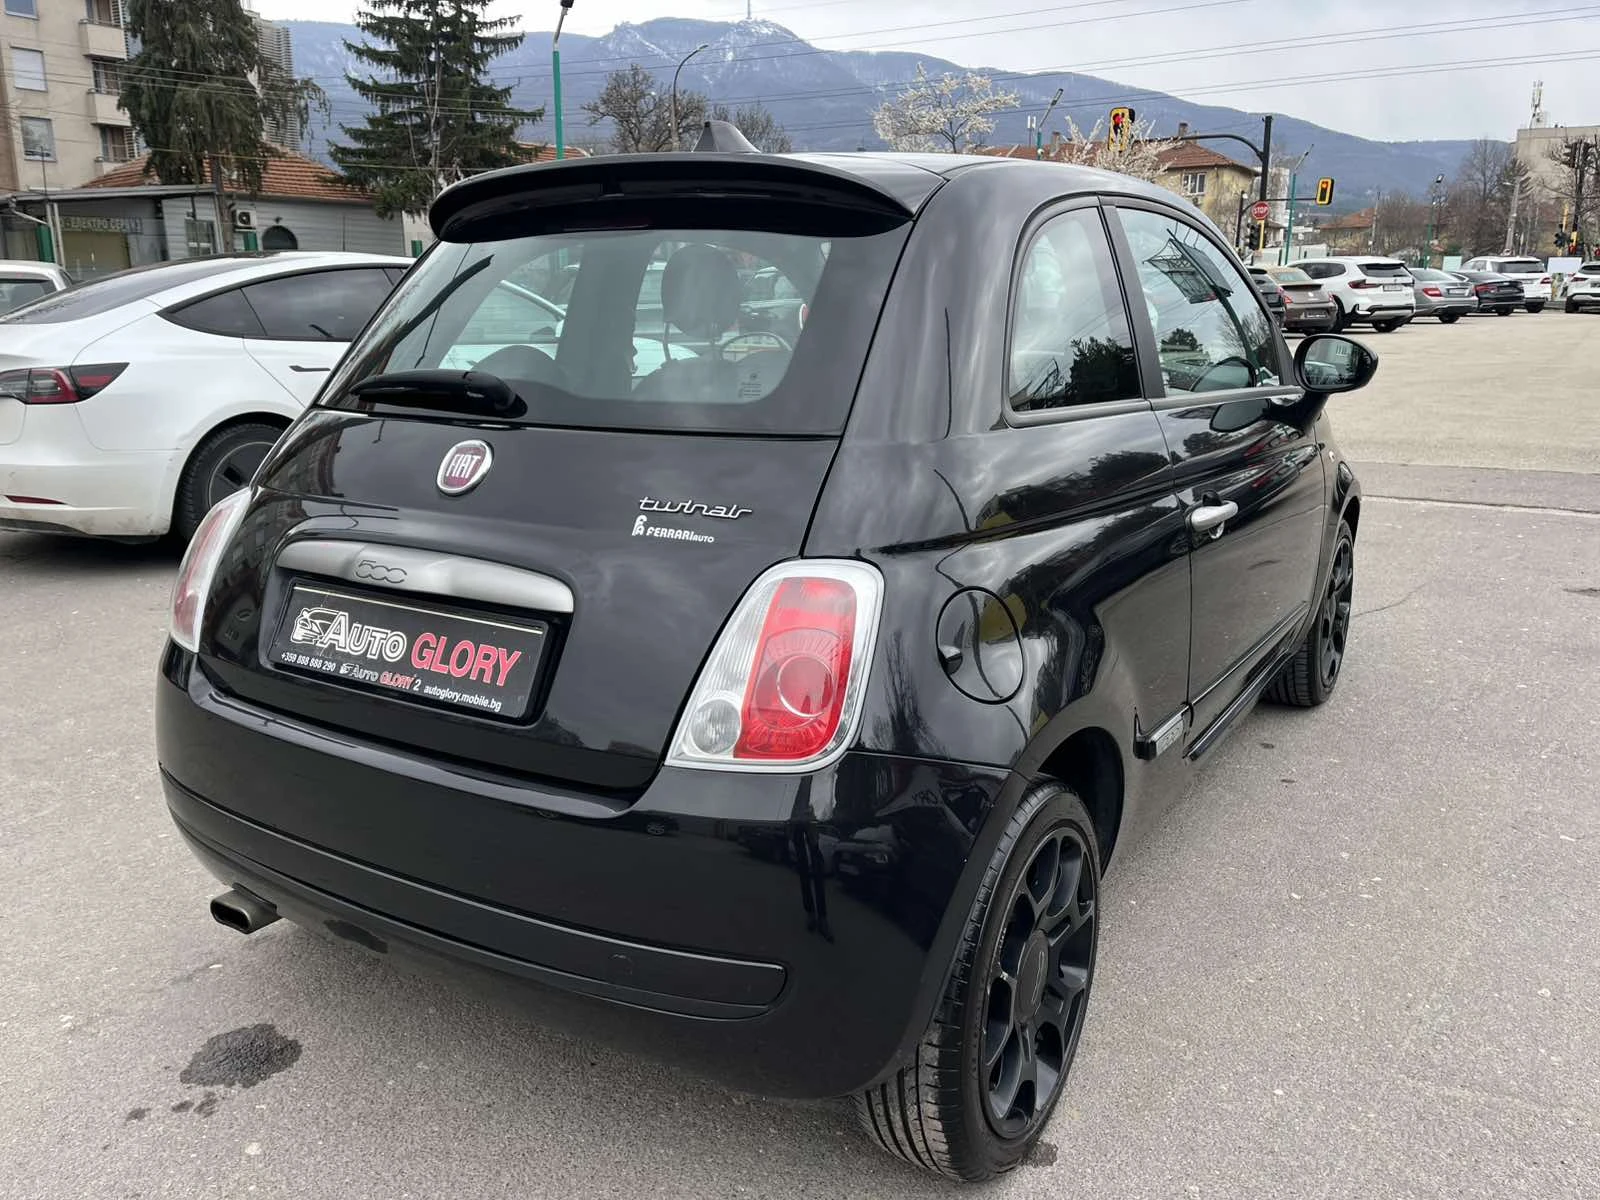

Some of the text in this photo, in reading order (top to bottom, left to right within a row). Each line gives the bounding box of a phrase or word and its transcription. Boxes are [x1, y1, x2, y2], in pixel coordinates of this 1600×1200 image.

[1253, 206, 1269, 215] STOP
[446, 453, 482, 479] FIAT
[639, 496, 753, 519] twinair
[355, 559, 408, 584] 500
[281, 652, 297, 663] +359
[322, 660, 337, 672] 290
[411, 632, 522, 687] GLORY
[379, 671, 415, 690] GLORY
[413, 678, 422, 691] 2
[424, 684, 502, 713] autoglory.mobile.bg
